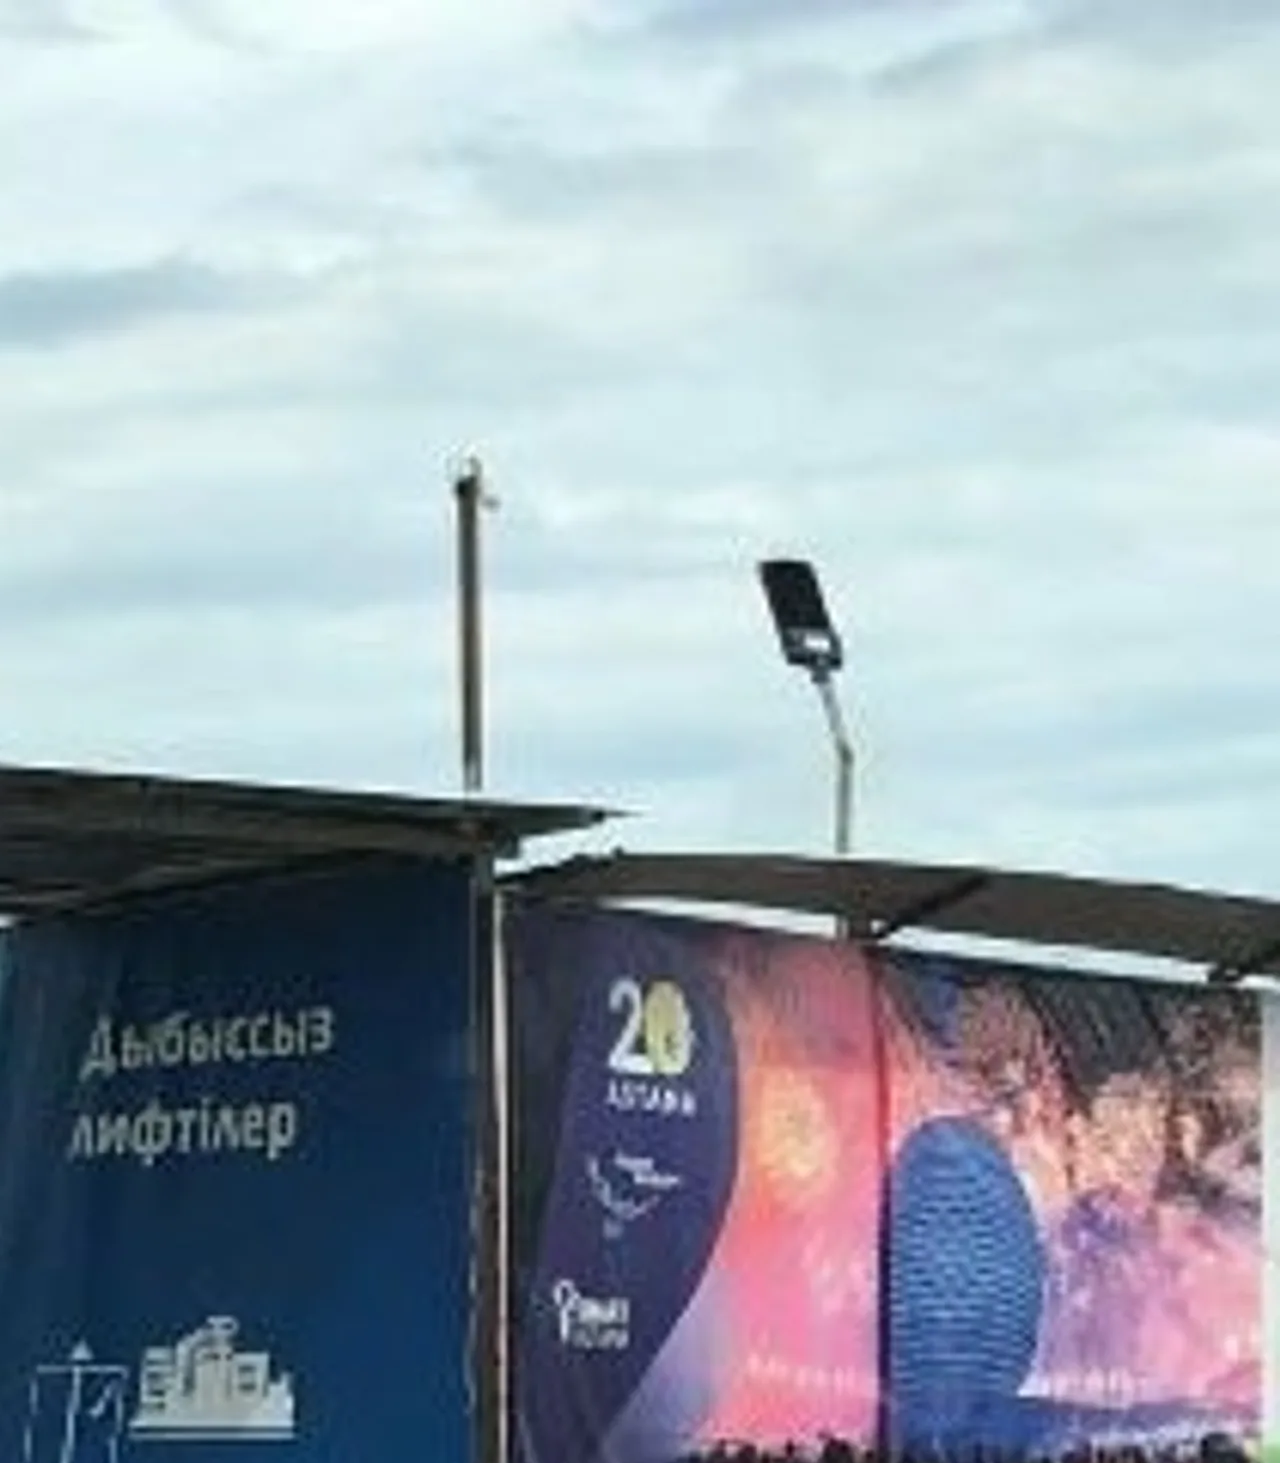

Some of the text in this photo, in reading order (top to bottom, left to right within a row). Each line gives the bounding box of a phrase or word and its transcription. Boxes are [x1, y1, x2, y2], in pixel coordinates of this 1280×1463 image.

[78, 1005, 334, 1083] Дыбыссыз
[607, 979, 695, 1075] 20
[68, 1098, 297, 1166] лифтілер
